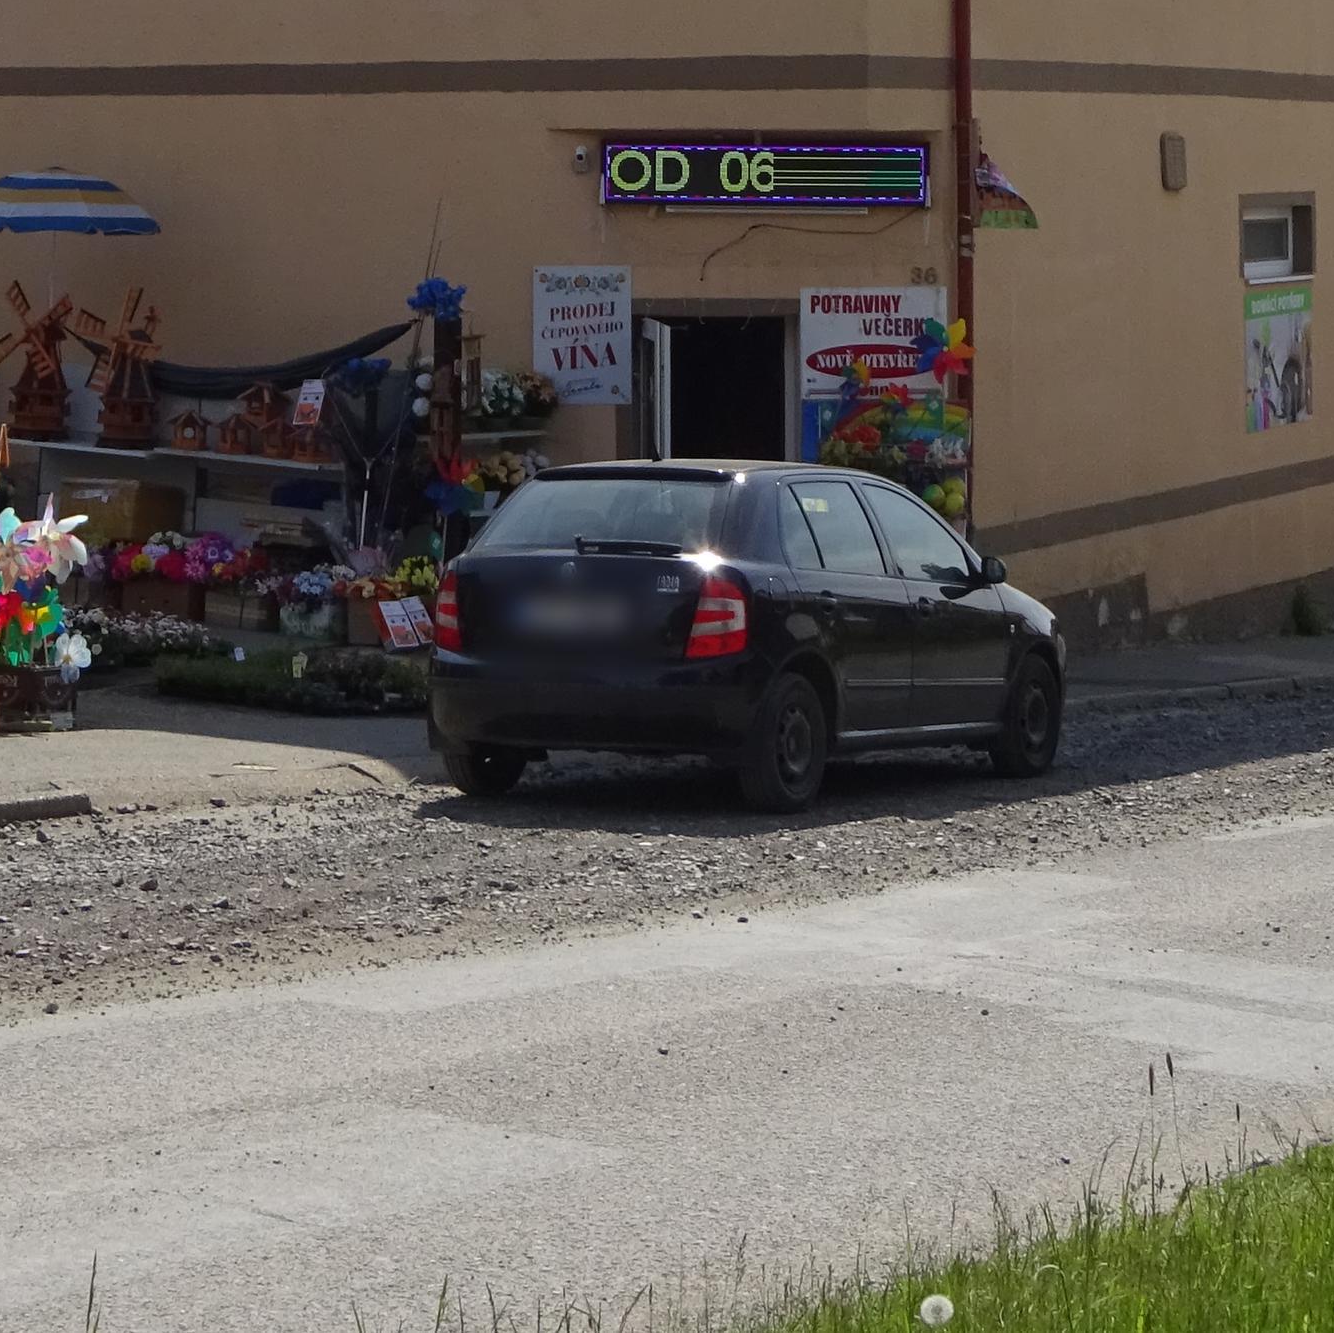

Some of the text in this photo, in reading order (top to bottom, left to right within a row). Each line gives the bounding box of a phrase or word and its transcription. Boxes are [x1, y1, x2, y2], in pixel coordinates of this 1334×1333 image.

[610, 150, 690, 192] OD
[911, 267, 938, 285] 36
[549, 301, 616, 323] PRODEJ
[810, 294, 902, 315] POTRAVINY
[862, 313, 925, 337] VEČERK
[551, 338, 618, 372] VÍNA
[861, 349, 922, 369] OTEVŘE
